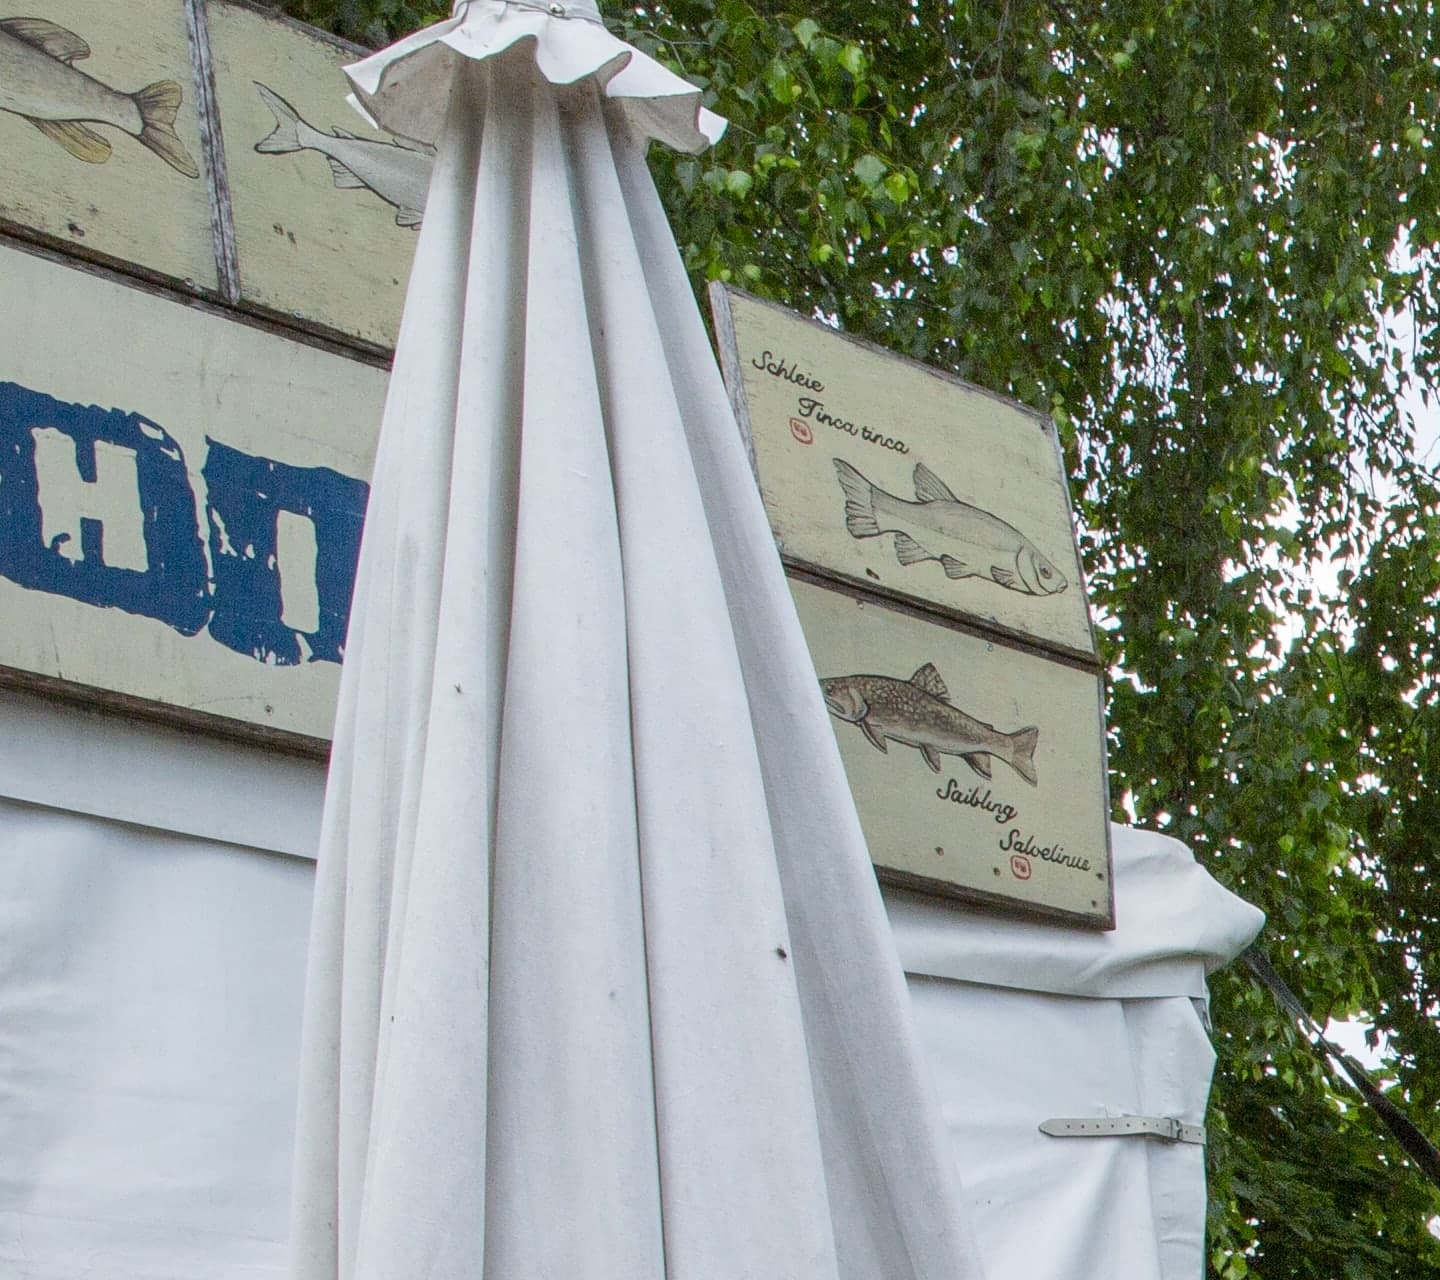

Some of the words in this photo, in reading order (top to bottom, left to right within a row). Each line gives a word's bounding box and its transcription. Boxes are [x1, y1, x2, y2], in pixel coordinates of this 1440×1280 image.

[752, 351, 825, 392] Schleie
[798, 397, 858, 436] Tinca
[861, 425, 909, 455] tinca
[936, 778, 1018, 824] Saibling
[999, 829, 1091, 872] Salvelinus
